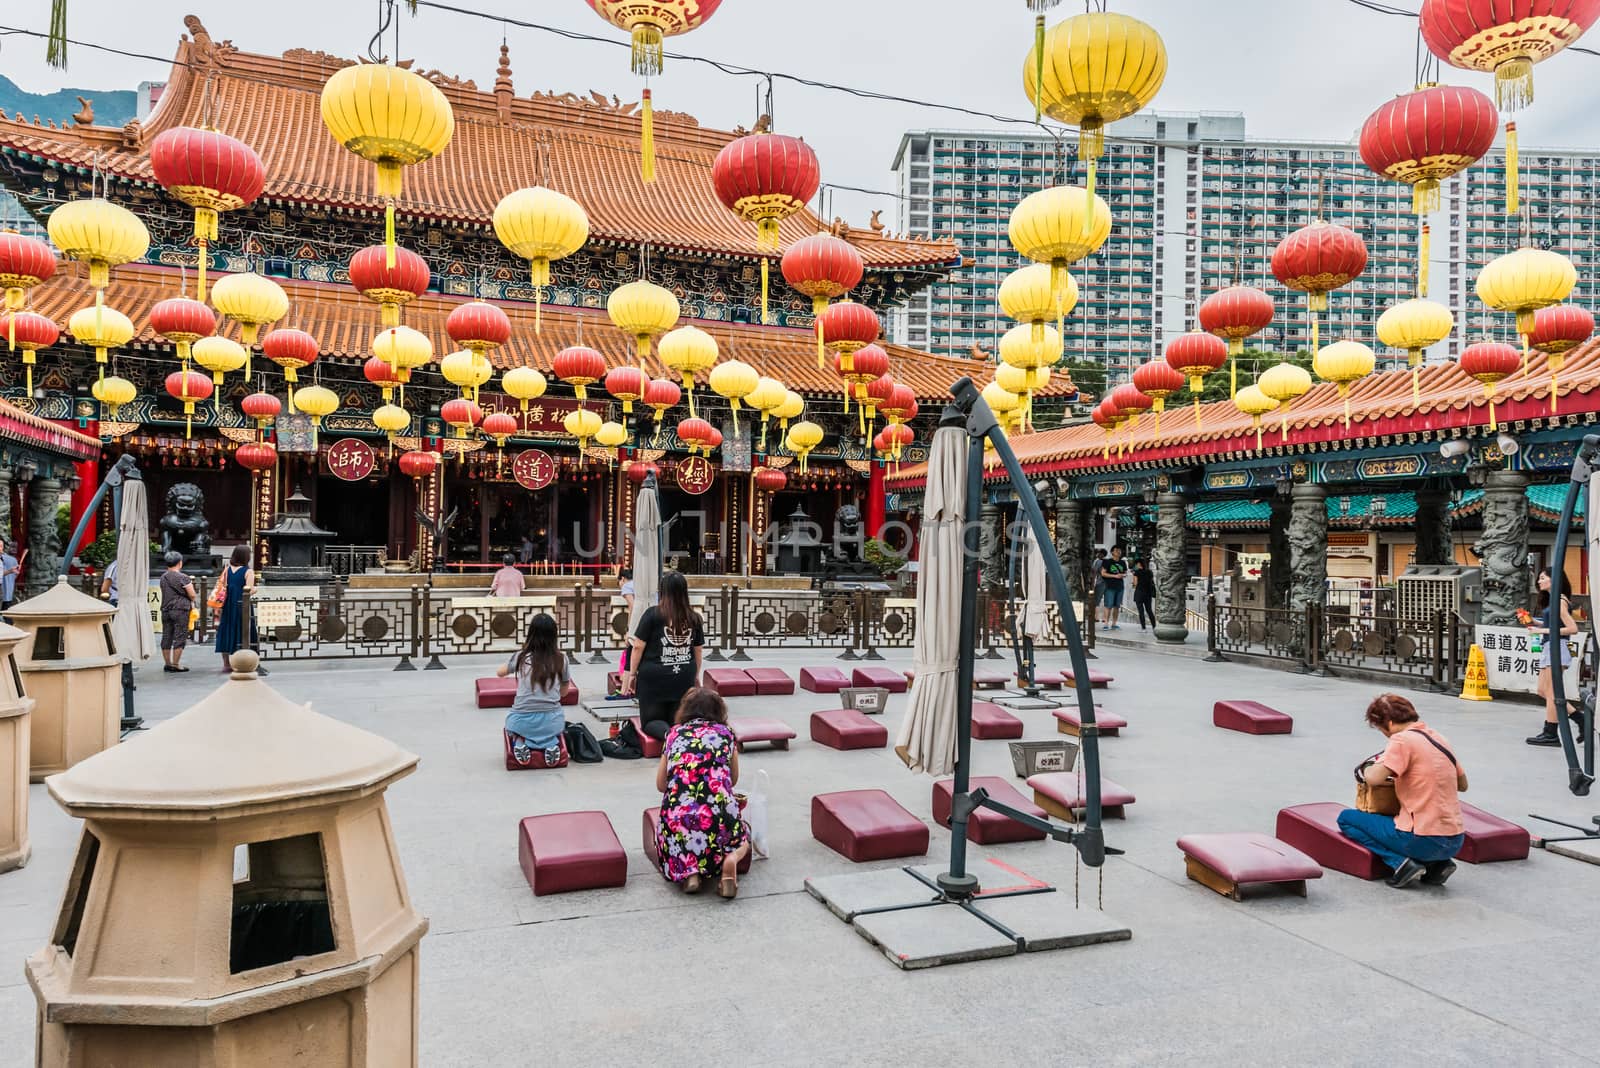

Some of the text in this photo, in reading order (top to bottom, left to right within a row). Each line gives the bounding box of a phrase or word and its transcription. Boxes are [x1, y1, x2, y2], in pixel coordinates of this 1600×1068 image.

[339, 447, 362, 471] 師
[522, 457, 544, 482] 道
[1482, 633, 1579, 657] 通道及口
